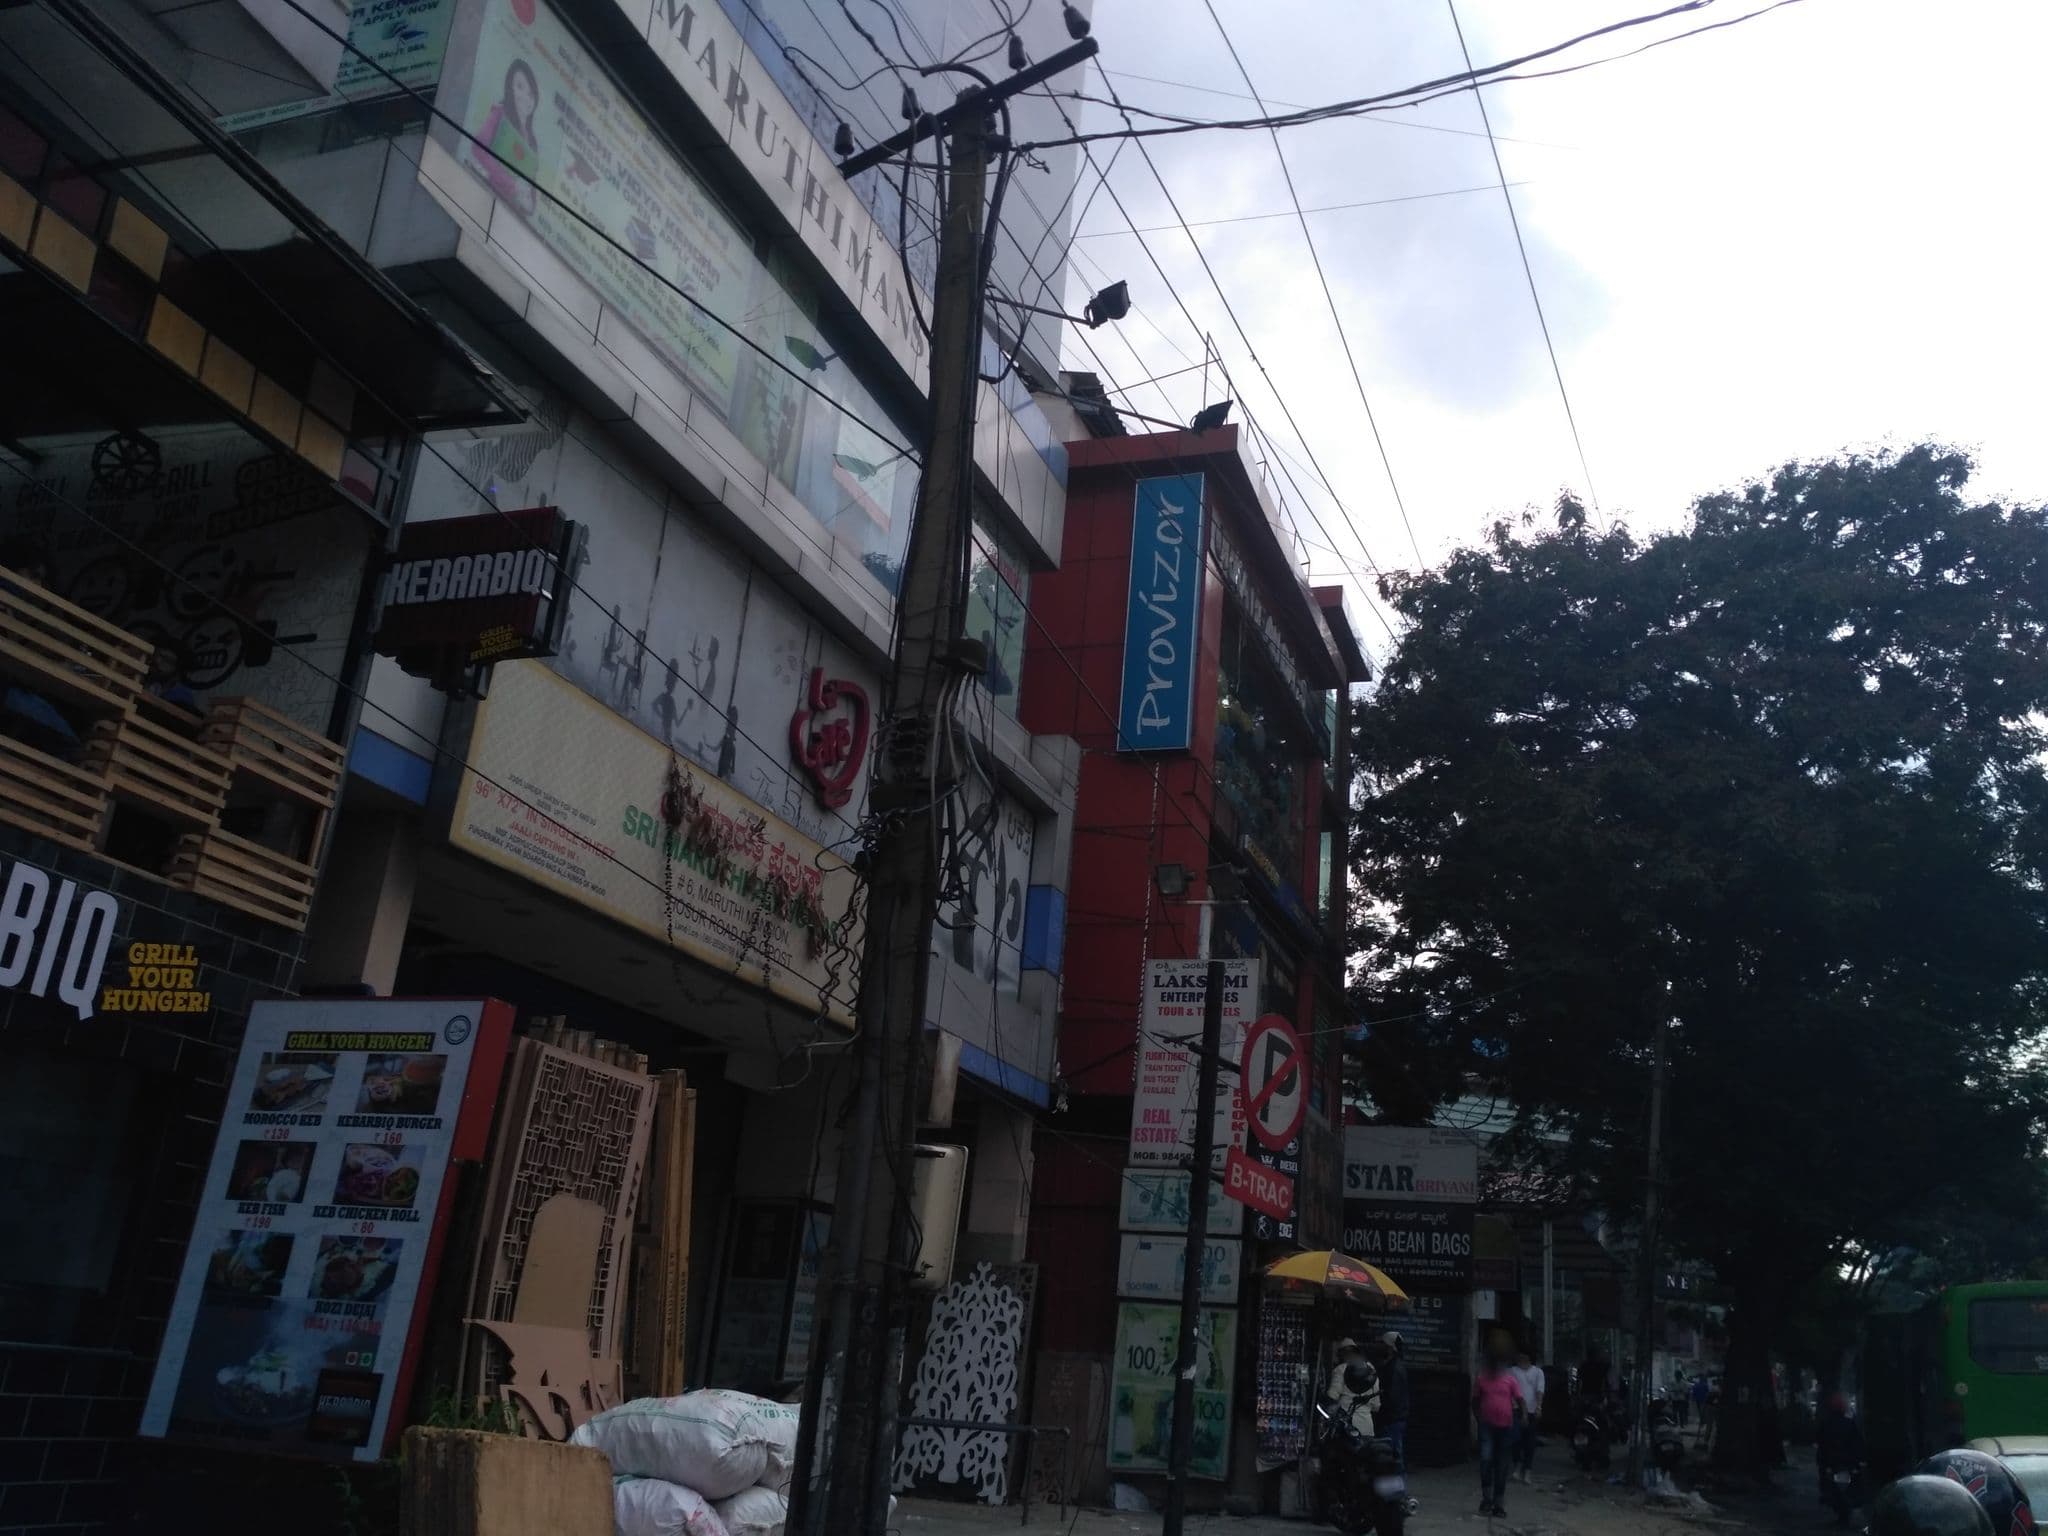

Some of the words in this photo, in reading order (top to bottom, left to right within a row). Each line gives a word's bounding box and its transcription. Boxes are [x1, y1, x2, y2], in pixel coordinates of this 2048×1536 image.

[384, 548, 544, 606] KEBARBIQ
[622, 805, 660, 849] SRI
[699, 884, 745, 920] MARUTHI
[128, 942, 199, 966] GRILL
[128, 966, 195, 989] YOUR
[1154, 975, 1248, 988] LAKSMI
[101, 989, 211, 1013] HUNGER!
[1158, 1006, 1184, 1017] TOUR
[287, 1032, 332, 1050] GRILL
[329, 1033, 366, 1050] YOUR
[368, 1034, 432, 1051] HUNGER!
[1145, 1064, 1162, 1072] TRAIN
[1163, 1065, 1186, 1073] TICKET
[1157, 1076, 1180, 1084] TICKET
[1142, 1086, 1176, 1095] AVAILABLE
[243, 1113, 298, 1126] MOROCCO
[299, 1114, 322, 1127] KEB
[337, 1115, 395, 1130] KEBARBIQ
[396, 1116, 443, 1130] BURGER
[1142, 1109, 1171, 1125] REAL
[1134, 1127, 1179, 1144] ESTATE
[1133, 1151, 1160, 1161] MOB:
[1346, 1163, 1414, 1192] STAR
[1231, 1165, 1289, 1209] B-TRAC
[263, 1203, 287, 1217] FISH
[313, 1205, 336, 1218] KEB
[338, 1206, 388, 1221] CHICKEN
[390, 1208, 420, 1222] ROLL
[1344, 1229, 1382, 1252] ORKA
[1388, 1230, 1425, 1254] BEAN
[1431, 1231, 1471, 1256] BAGS
[1127, 1348, 1155, 1371] 100
